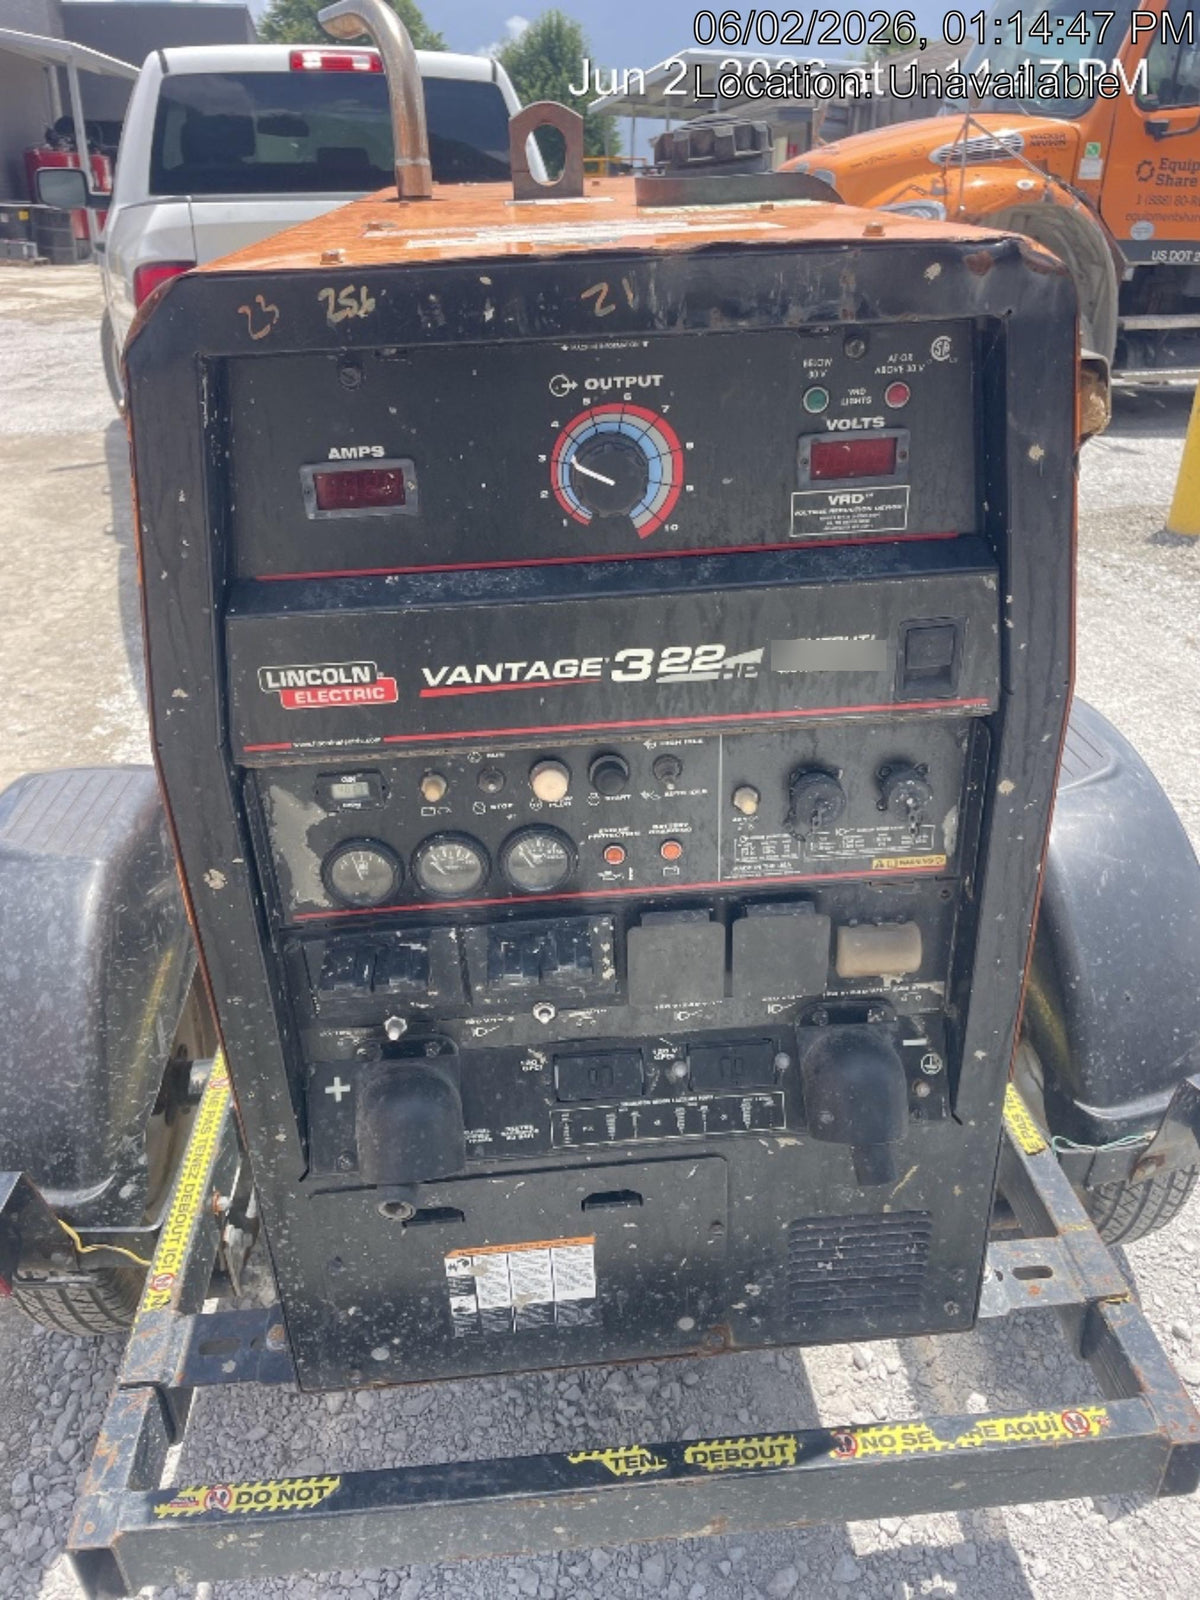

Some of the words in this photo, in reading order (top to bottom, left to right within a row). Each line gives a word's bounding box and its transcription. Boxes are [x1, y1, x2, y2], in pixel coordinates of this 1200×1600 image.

[1156, 174, 1198, 187] Share
[1151, 250, 1167, 261] US
[1169, 250, 1193, 262] DOT
[584, 374, 664, 391] OUTPUT
[582, 397, 591, 406] 5
[623, 392, 632, 401] 6
[841, 396, 872, 406] LIGHTS
[661, 404, 671, 413] 7
[550, 420, 560, 428] 4
[826, 416, 885, 431] VOLTS
[328, 445, 385, 459] AMPS
[538, 454, 547, 463] 3
[540, 489, 549, 499] 2
[828, 493, 865, 506] VRD
[664, 523, 679, 532] 10
[421, 656, 603, 687] VANTAGE
[611, 644, 727, 682] 322
[266, 665, 371, 689] LINCOLN
[294, 686, 385, 704] ELECTRIC
[170, 1182, 196, 1245] DEBOUT
[860, 1434, 896, 1451] NO
[901, 1430, 933, 1446] SE
[691, 1443, 789, 1465] DEBOUT
[235, 1490, 272, 1505] DO
[277, 1486, 329, 1502] NOT
